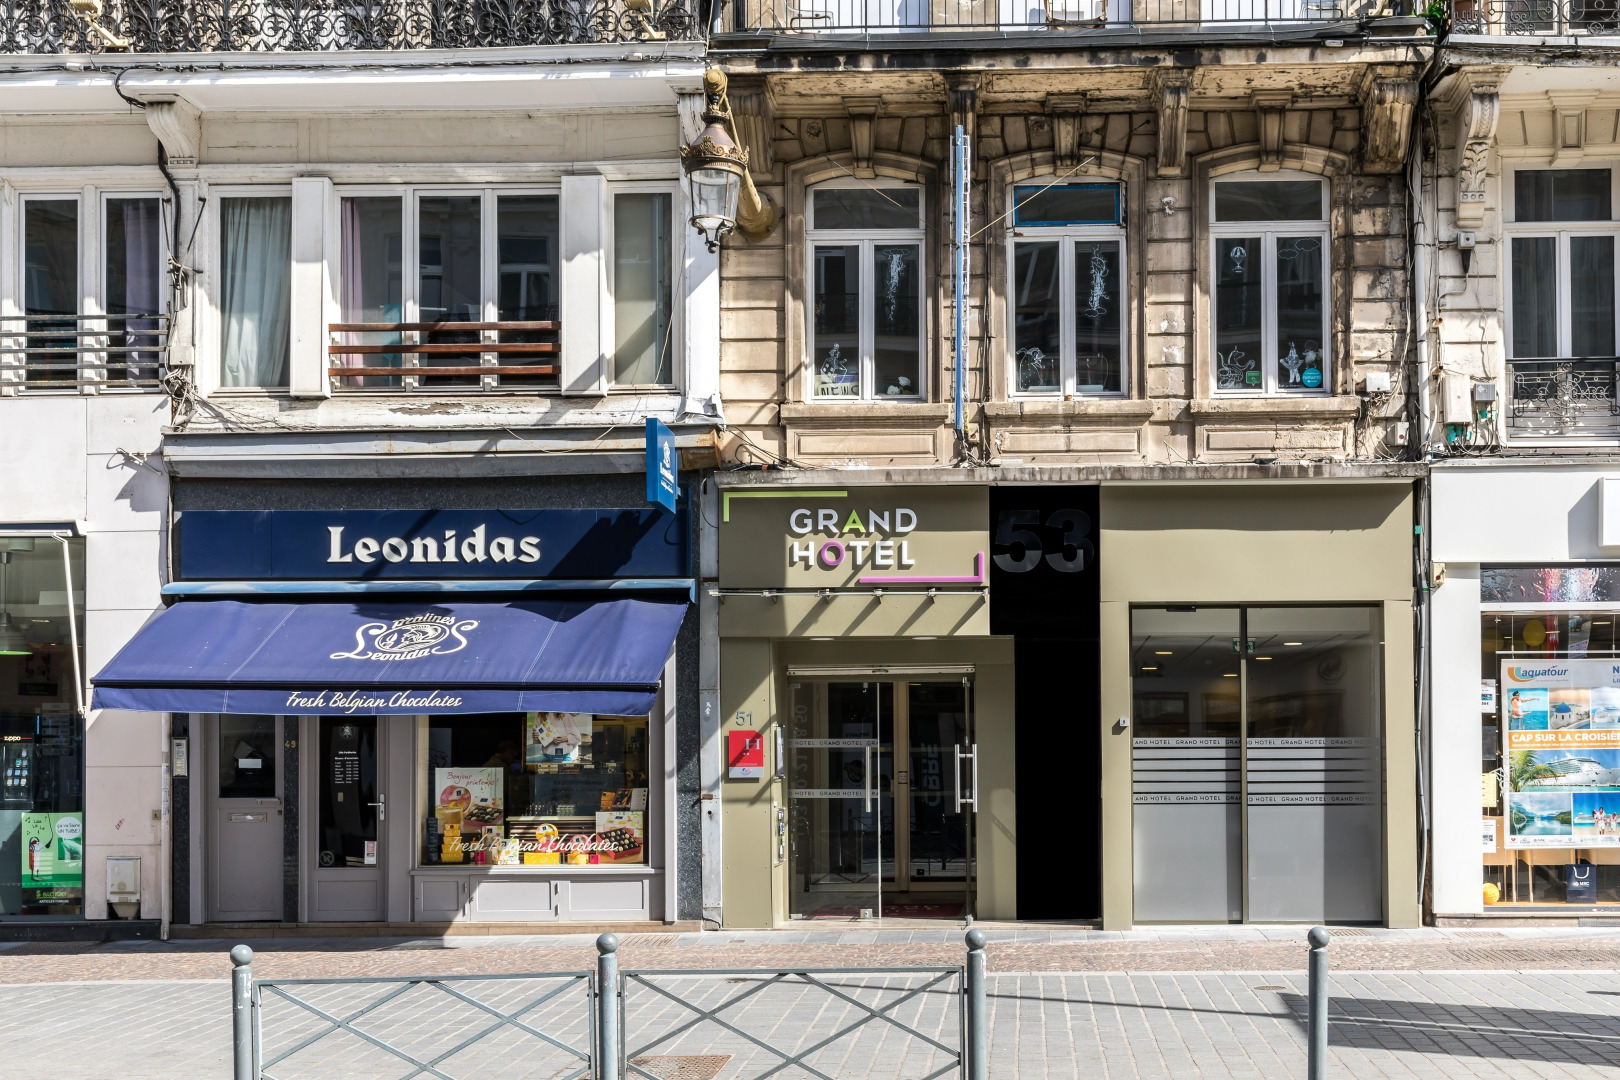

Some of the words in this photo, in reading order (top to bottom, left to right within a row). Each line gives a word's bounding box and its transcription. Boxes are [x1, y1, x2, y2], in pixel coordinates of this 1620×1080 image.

[789, 508, 918, 534] GRAND
[326, 523, 542, 563] Leonidas
[992, 508, 1095, 574] 53
[792, 540, 916, 566] HOTEL
[1521, 666, 1569, 678] aquatour
[286, 689, 329, 708] Fresh
[329, 689, 388, 714] Belgian
[388, 689, 463, 708] Chocolates
[735, 710, 754, 726] 51
[284, 739, 297, 749] 49
[744, 738, 761, 751] H
[1511, 733, 1534, 743] CAP
[1535, 733, 1557, 742] SUR
[1558, 732, 1574, 742] LA
[446, 771, 473, 785] Bonjour
[448, 834, 489, 852] Fresh
[546, 833, 619, 852] Chocolates
